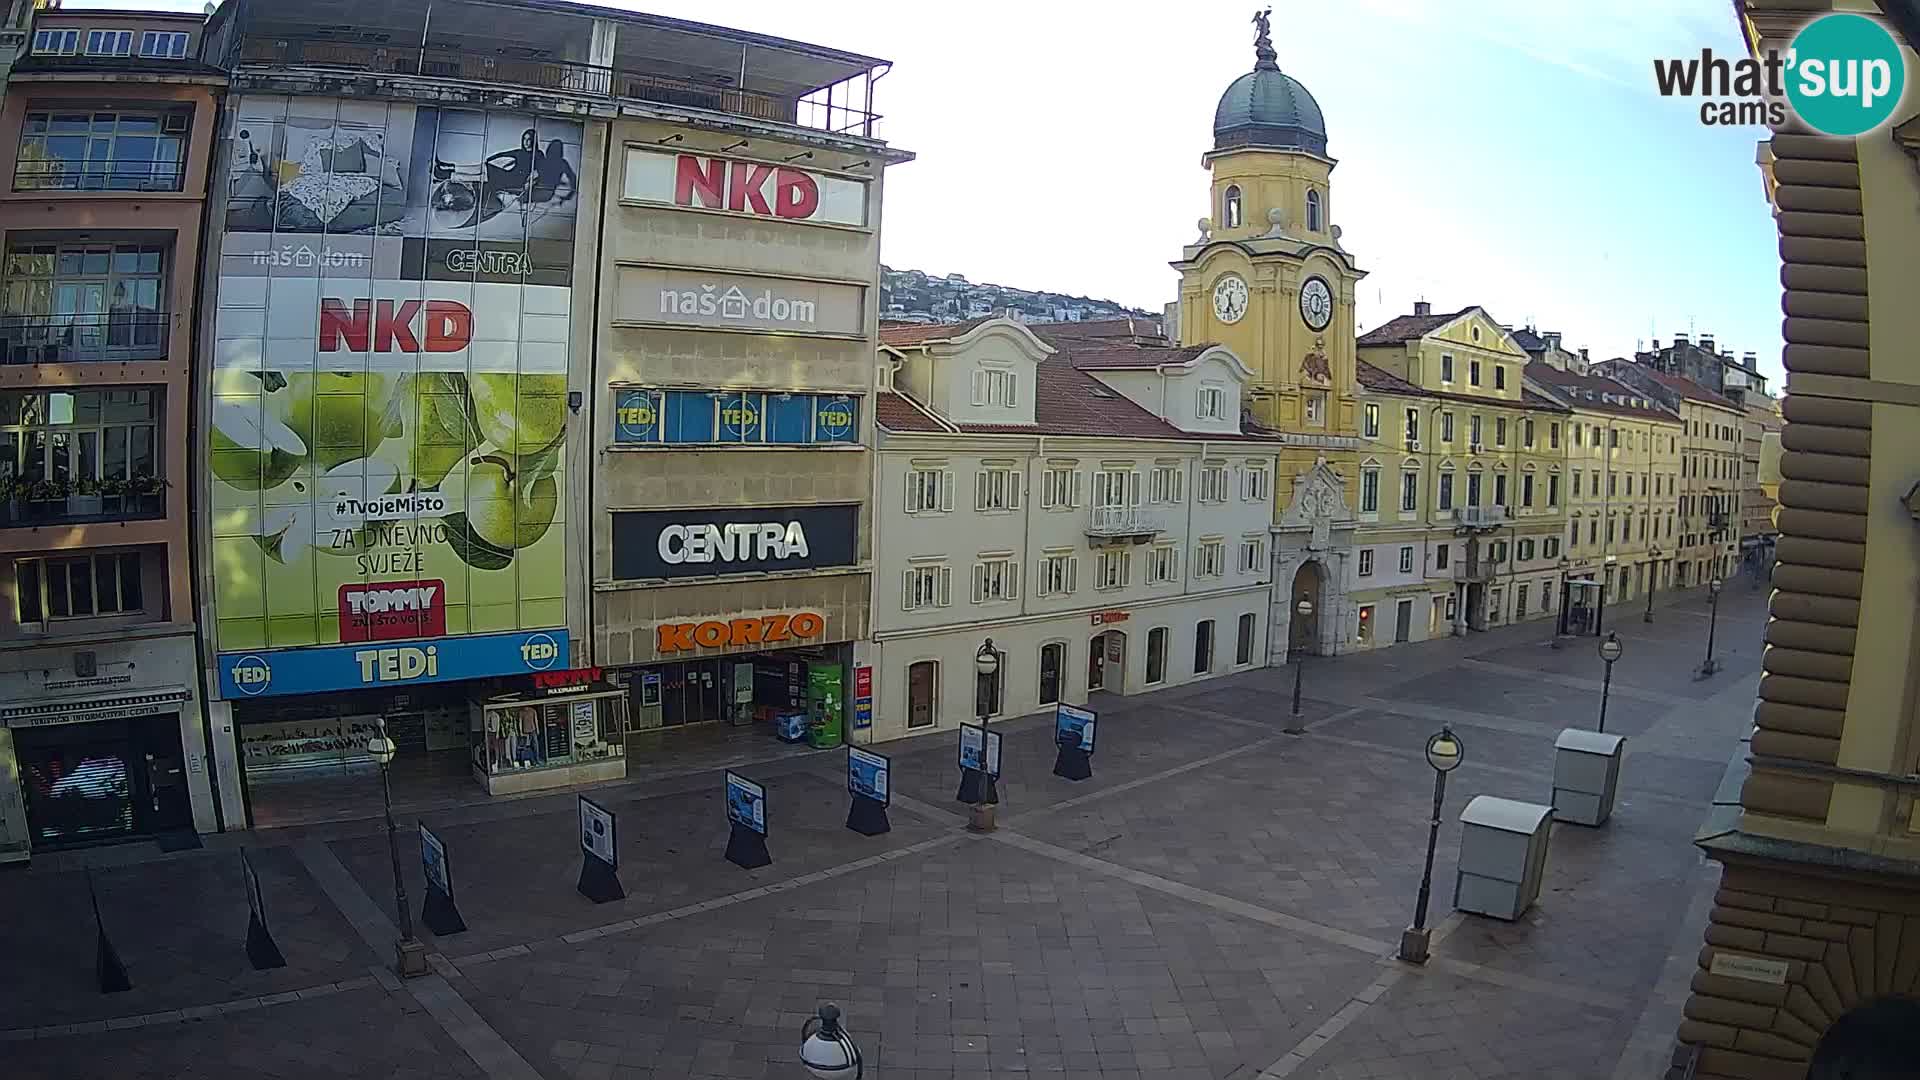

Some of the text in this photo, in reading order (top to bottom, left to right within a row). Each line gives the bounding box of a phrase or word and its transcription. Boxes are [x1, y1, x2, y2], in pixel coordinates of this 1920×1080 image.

[676, 154, 819, 219] NKD
[251, 243, 364, 269] naš dom
[446, 248, 533, 276] CENTRA
[660, 284, 816, 323] naš dom
[319, 298, 474, 354] NKD
[617, 406, 657, 425] TEDi
[722, 408, 759, 425] TEDi
[818, 410, 852, 427] TEDi
[335, 496, 444, 516] #TvojeMisto
[331, 523, 448, 549] ZA DNEVNO
[657, 521, 809, 565] CENTRA
[357, 551, 425, 576] SVJEŽE
[347, 587, 438, 614] TOMMY
[656, 612, 825, 654] KORZO
[356, 645, 438, 683] TEDi
[520, 643, 558, 662] TEDi
[232, 661, 272, 686] TEDi
